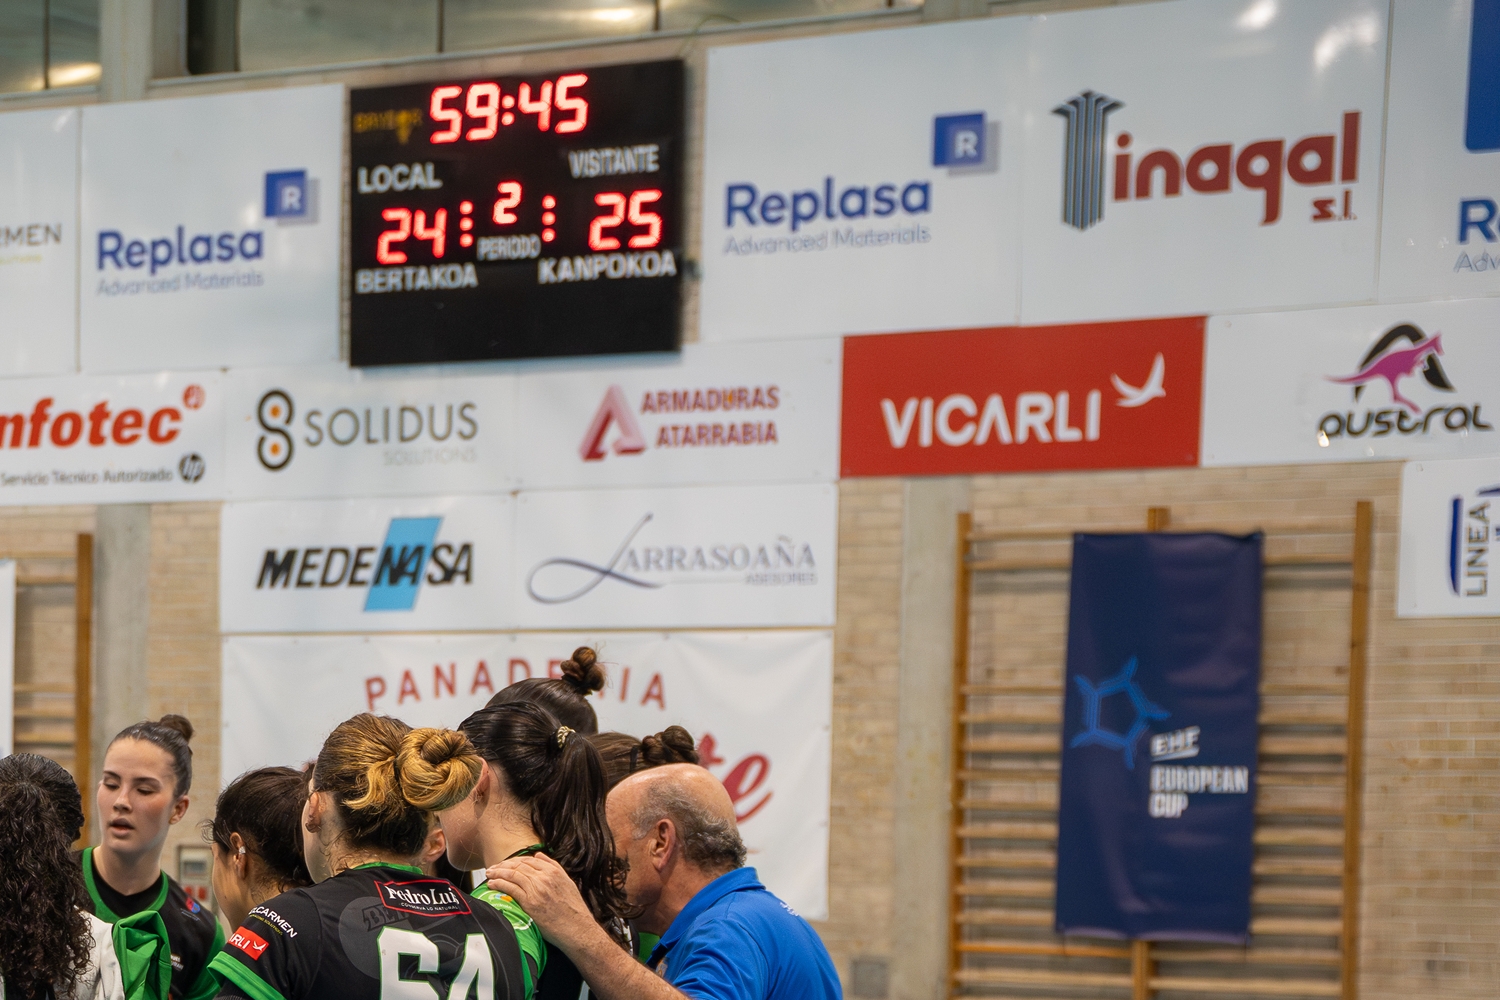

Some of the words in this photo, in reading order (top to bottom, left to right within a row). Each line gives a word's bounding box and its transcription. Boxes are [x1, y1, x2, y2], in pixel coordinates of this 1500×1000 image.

[429, 73, 590, 144] 59:45
[568, 144, 660, 178] VISITANTE
[357, 162, 443, 194] LOCAL
[724, 176, 933, 233] Replasa
[377, 207, 448, 265] 24
[492, 181, 523, 225] 2
[588, 189, 663, 251] 25
[834, 223, 933, 248] Materials
[97, 226, 264, 275] Replasa
[477, 234, 542, 260] PERIODO
[97, 272, 182, 297] Advanced
[184, 269, 264, 290] Materials
[356, 262, 479, 294] BERTAKOA
[538, 250, 678, 284] KANPOKOA
[641, 385, 781, 415] ARMADURAS
[304, 402, 479, 447] SOLIDUS
[656, 420, 779, 448] ATARRABIA
[881, 388, 1102, 449] VICARLI
[0, 471, 49, 487] Servicio
[102, 467, 173, 484] Autorizado
[256, 542, 474, 590] MEDENASA
[1150, 726, 1200, 757] EHF
[1150, 765, 1249, 794] EUROPEAN
[1148, 793, 1189, 818] CUP
